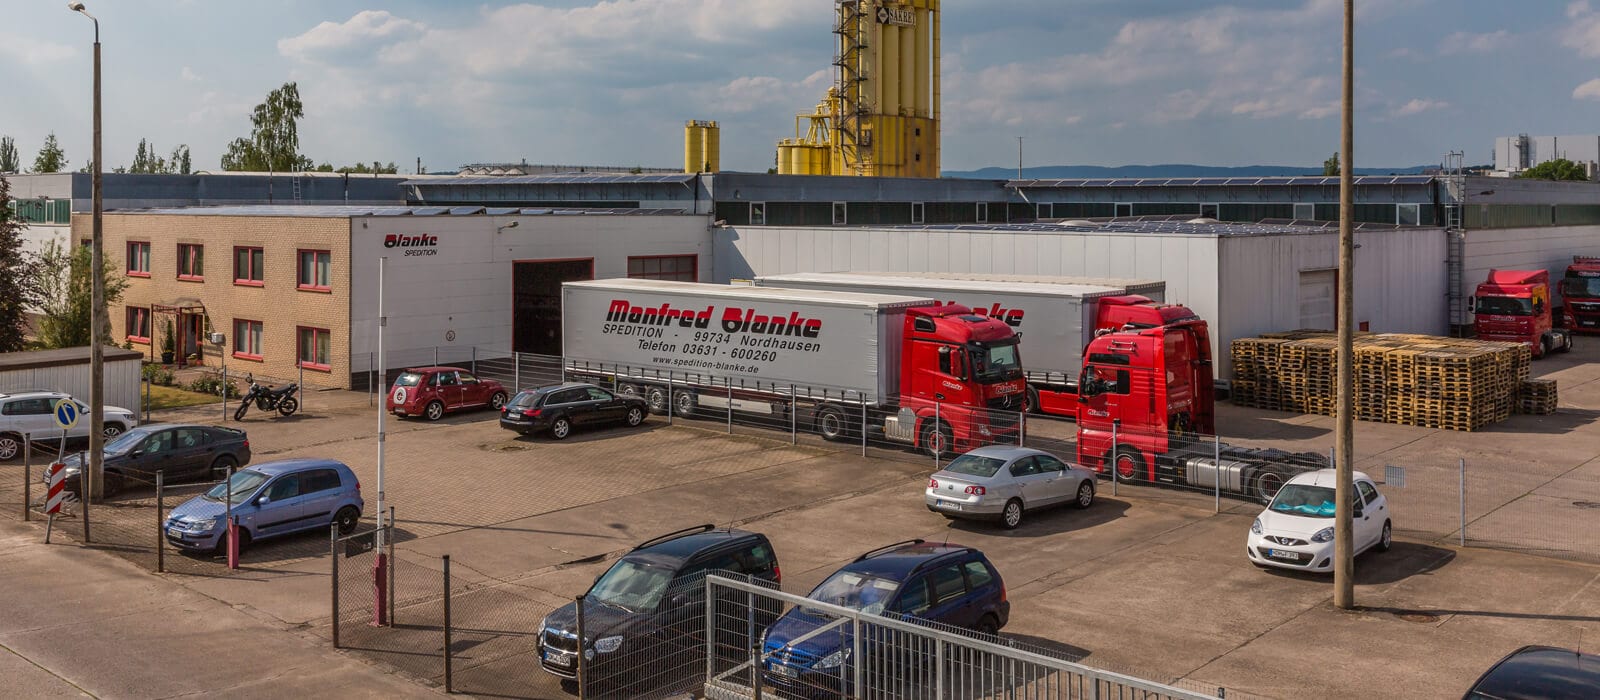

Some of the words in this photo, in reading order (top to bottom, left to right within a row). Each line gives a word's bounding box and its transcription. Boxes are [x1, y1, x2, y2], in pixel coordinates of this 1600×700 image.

[384, 233, 438, 248] Blanke
[404, 249, 438, 257] SPEDITION
[606, 299, 714, 329] Manfred
[722, 307, 822, 338] Blanke
[602, 323, 663, 338] SPEDITION
[694, 331, 731, 344] 99734
[740, 335, 821, 352] Nordhausen
[638, 339, 676, 353] Telefon
[682, 343, 718, 356] 03631
[730, 347, 777, 362] 600260
[652, 356, 759, 374] www.spedition-blanke.de
